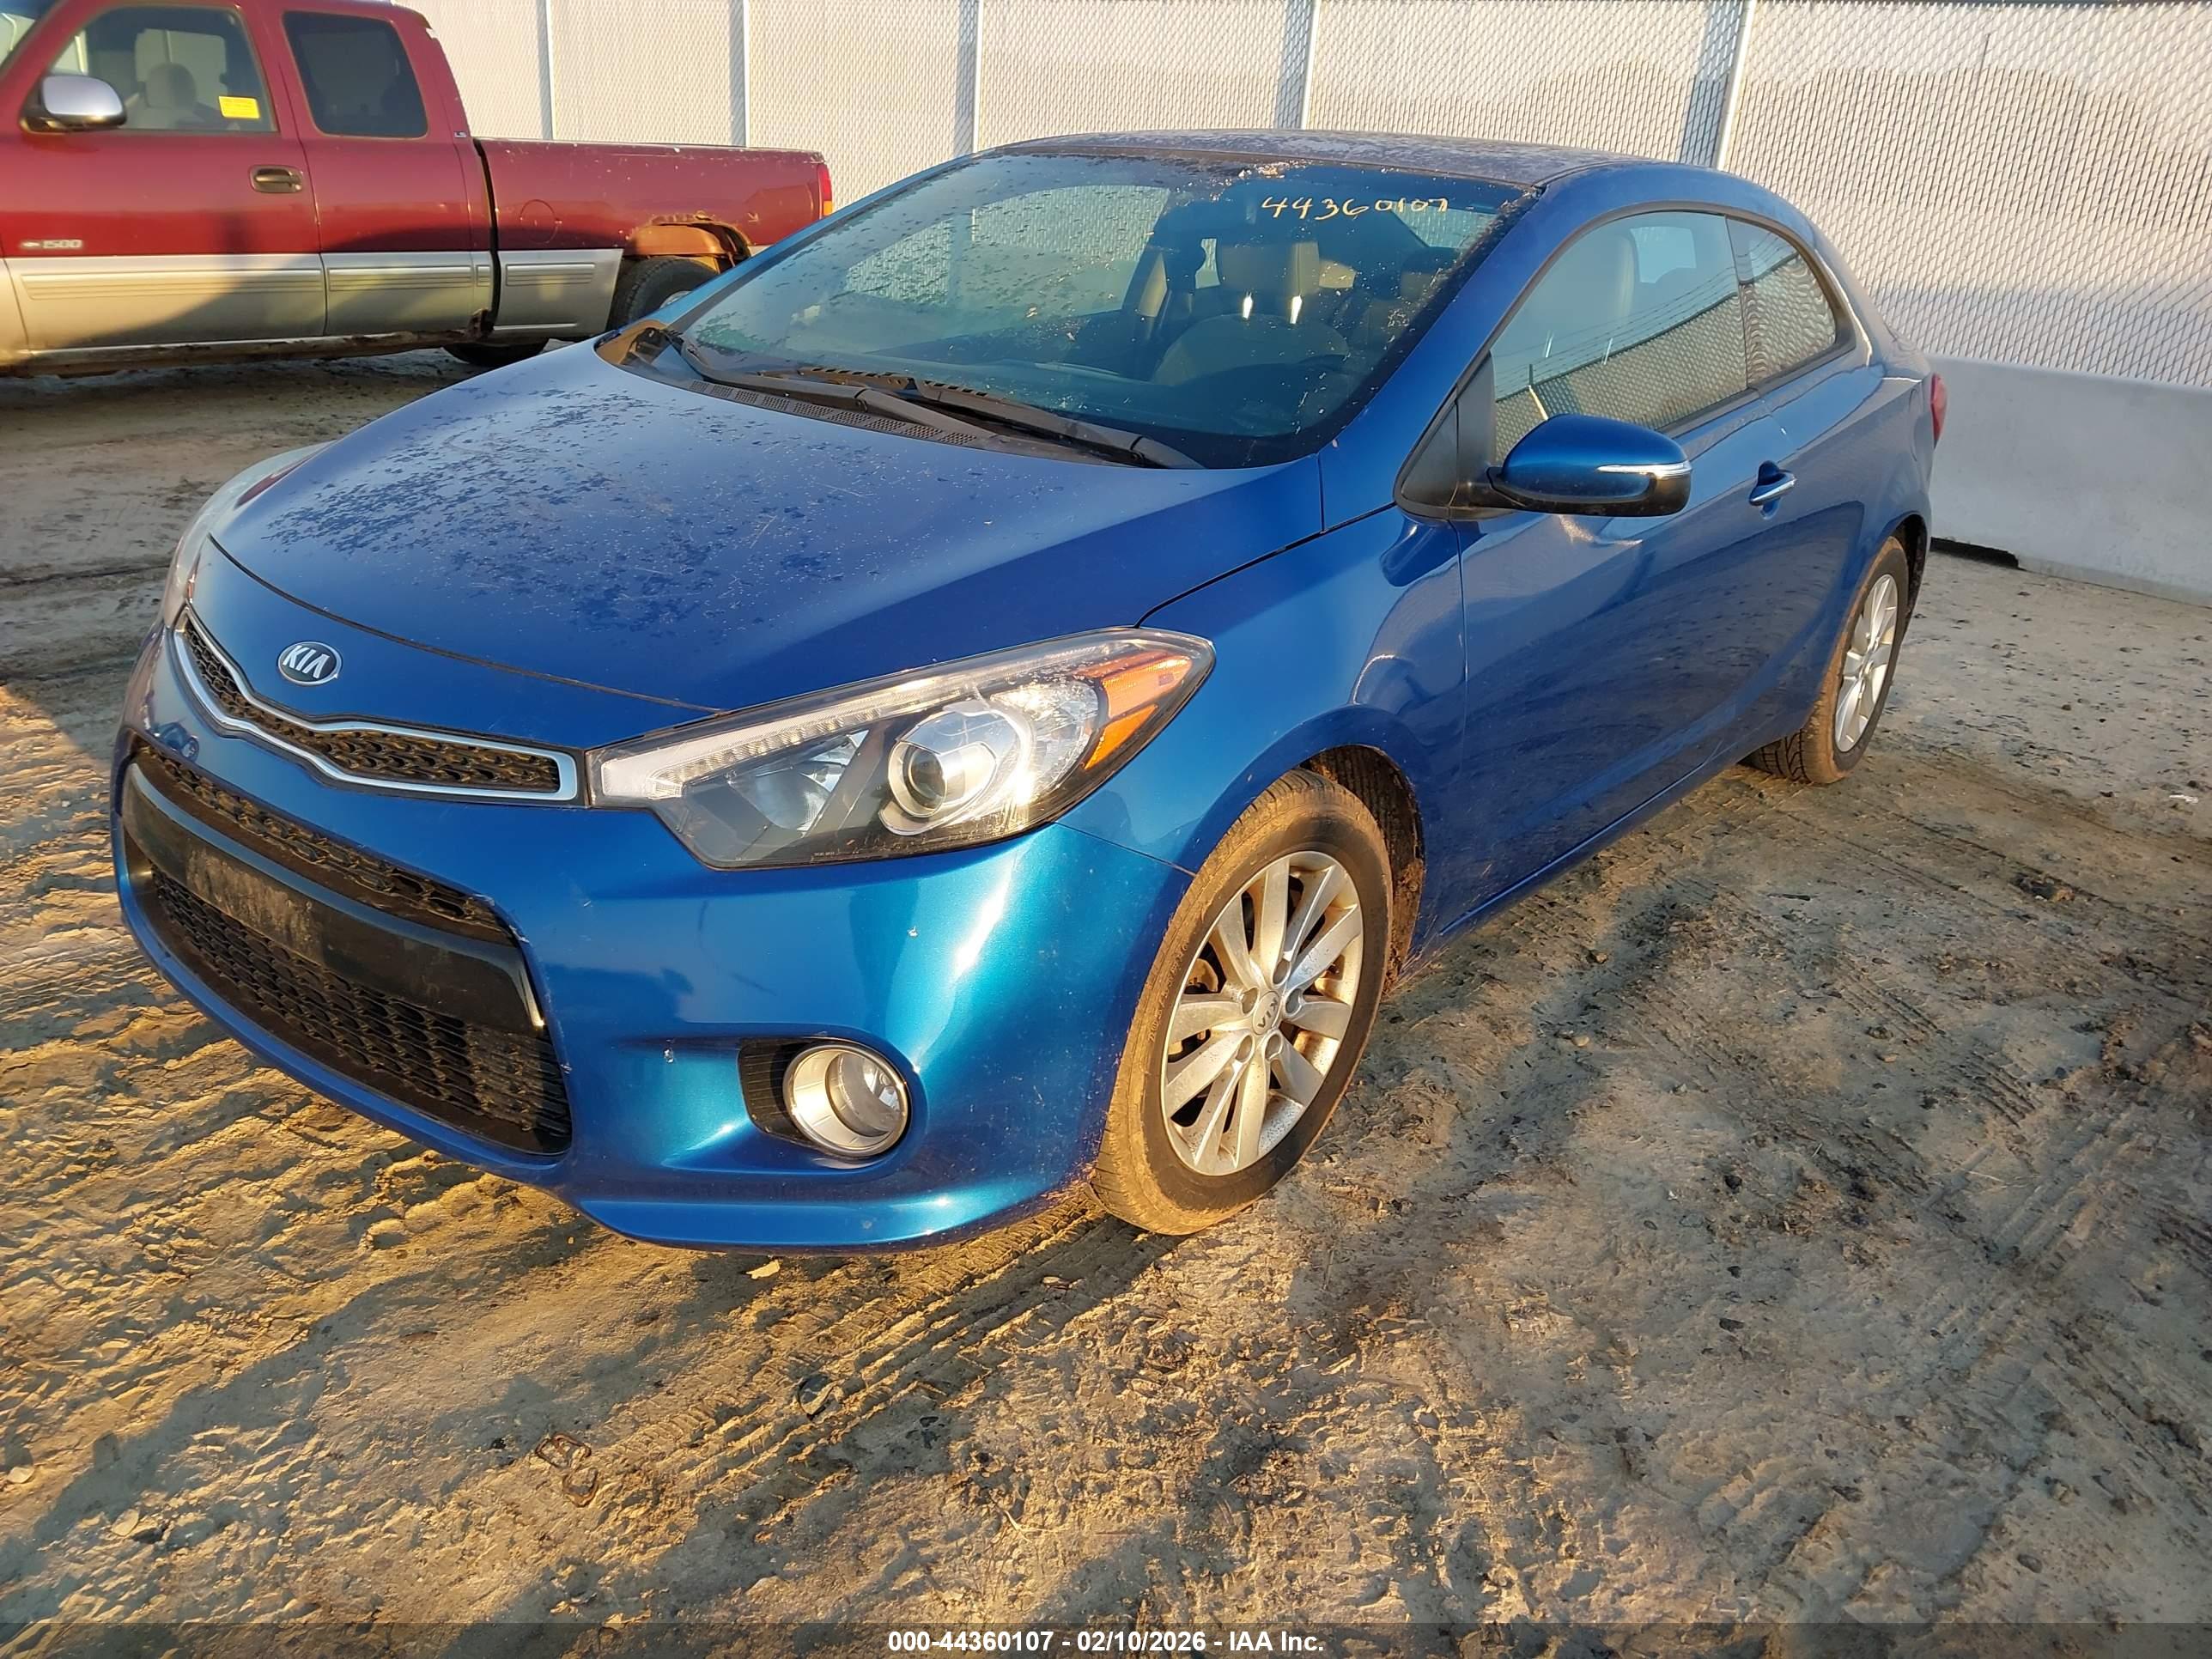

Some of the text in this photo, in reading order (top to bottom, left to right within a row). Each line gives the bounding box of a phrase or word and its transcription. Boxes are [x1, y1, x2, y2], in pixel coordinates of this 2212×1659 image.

[1261, 196, 1449, 221] 44360107
[43, 239, 82, 249] 1500
[282, 645, 331, 679] KIA
[1256, 997, 1279, 1029] KIA
